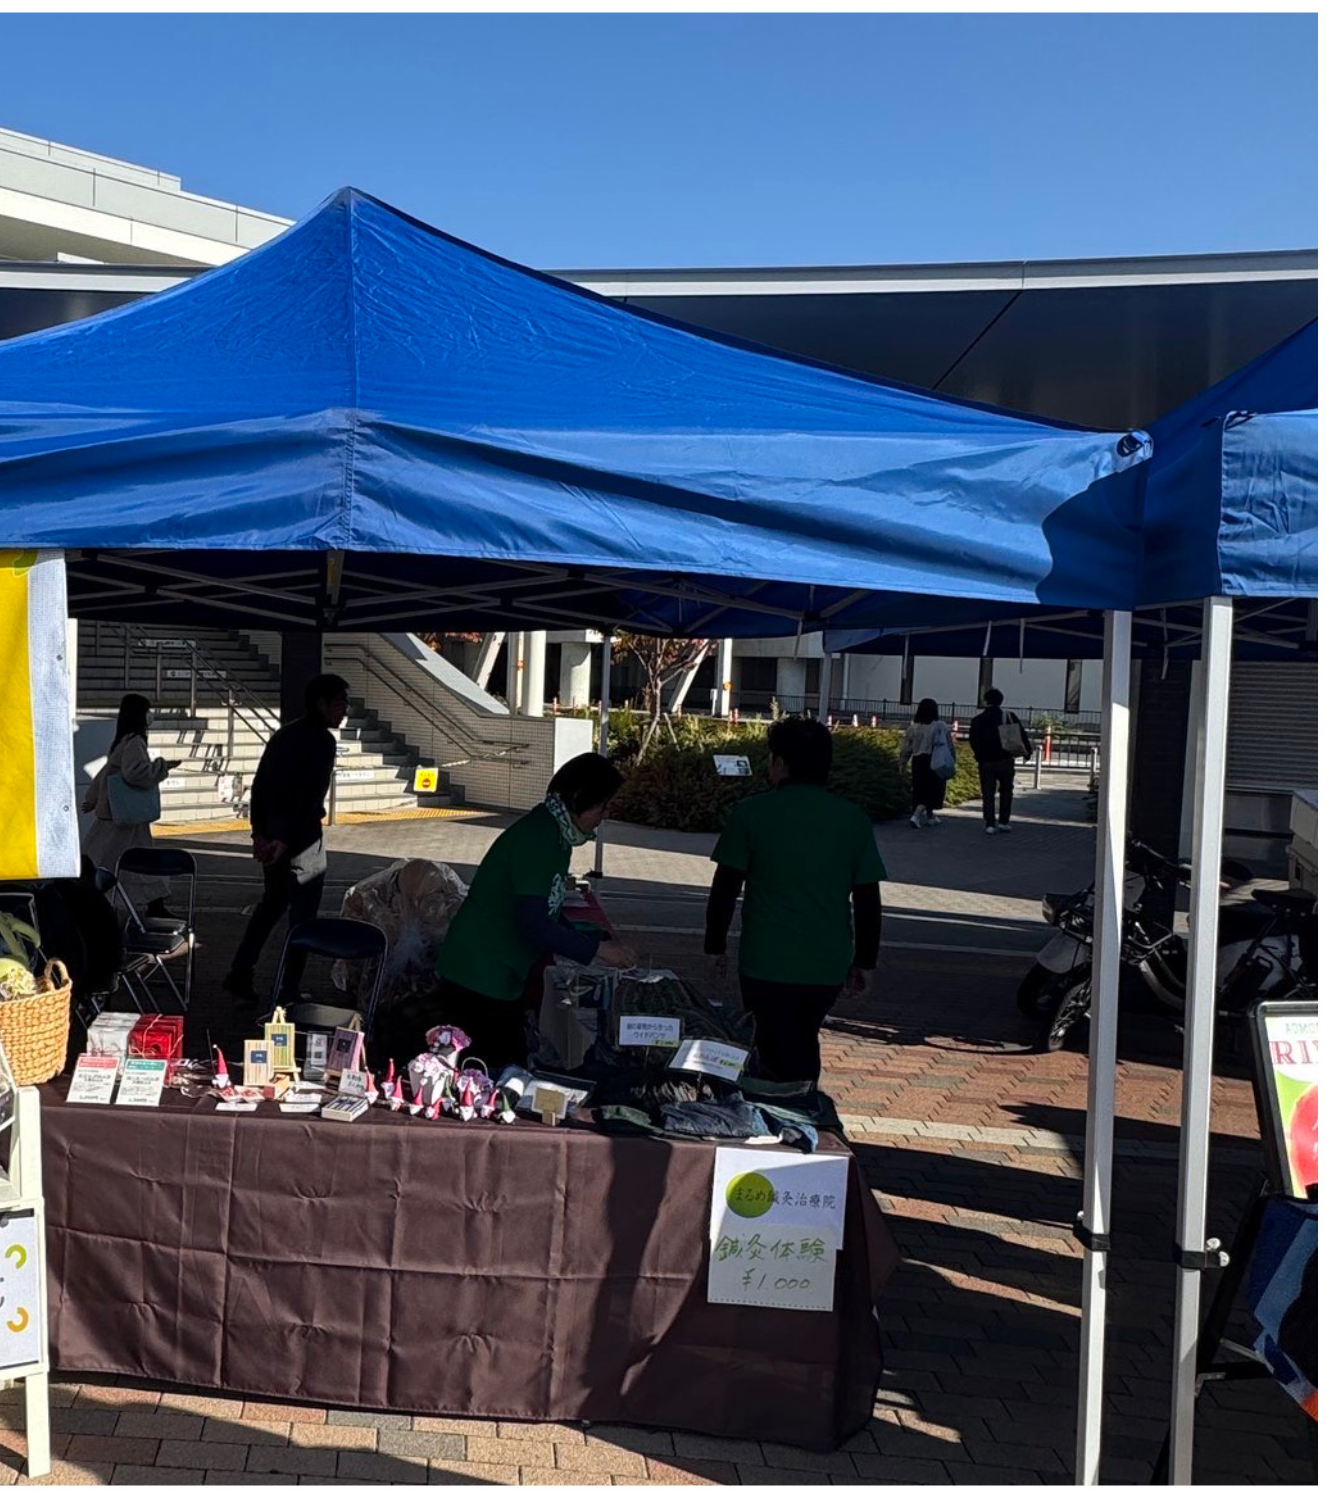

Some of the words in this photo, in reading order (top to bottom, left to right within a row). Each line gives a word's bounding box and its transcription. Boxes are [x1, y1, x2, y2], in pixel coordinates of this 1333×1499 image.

[1269, 1039, 1318, 1065] RI
[715, 1232, 829, 1263] 鍼灸体験
